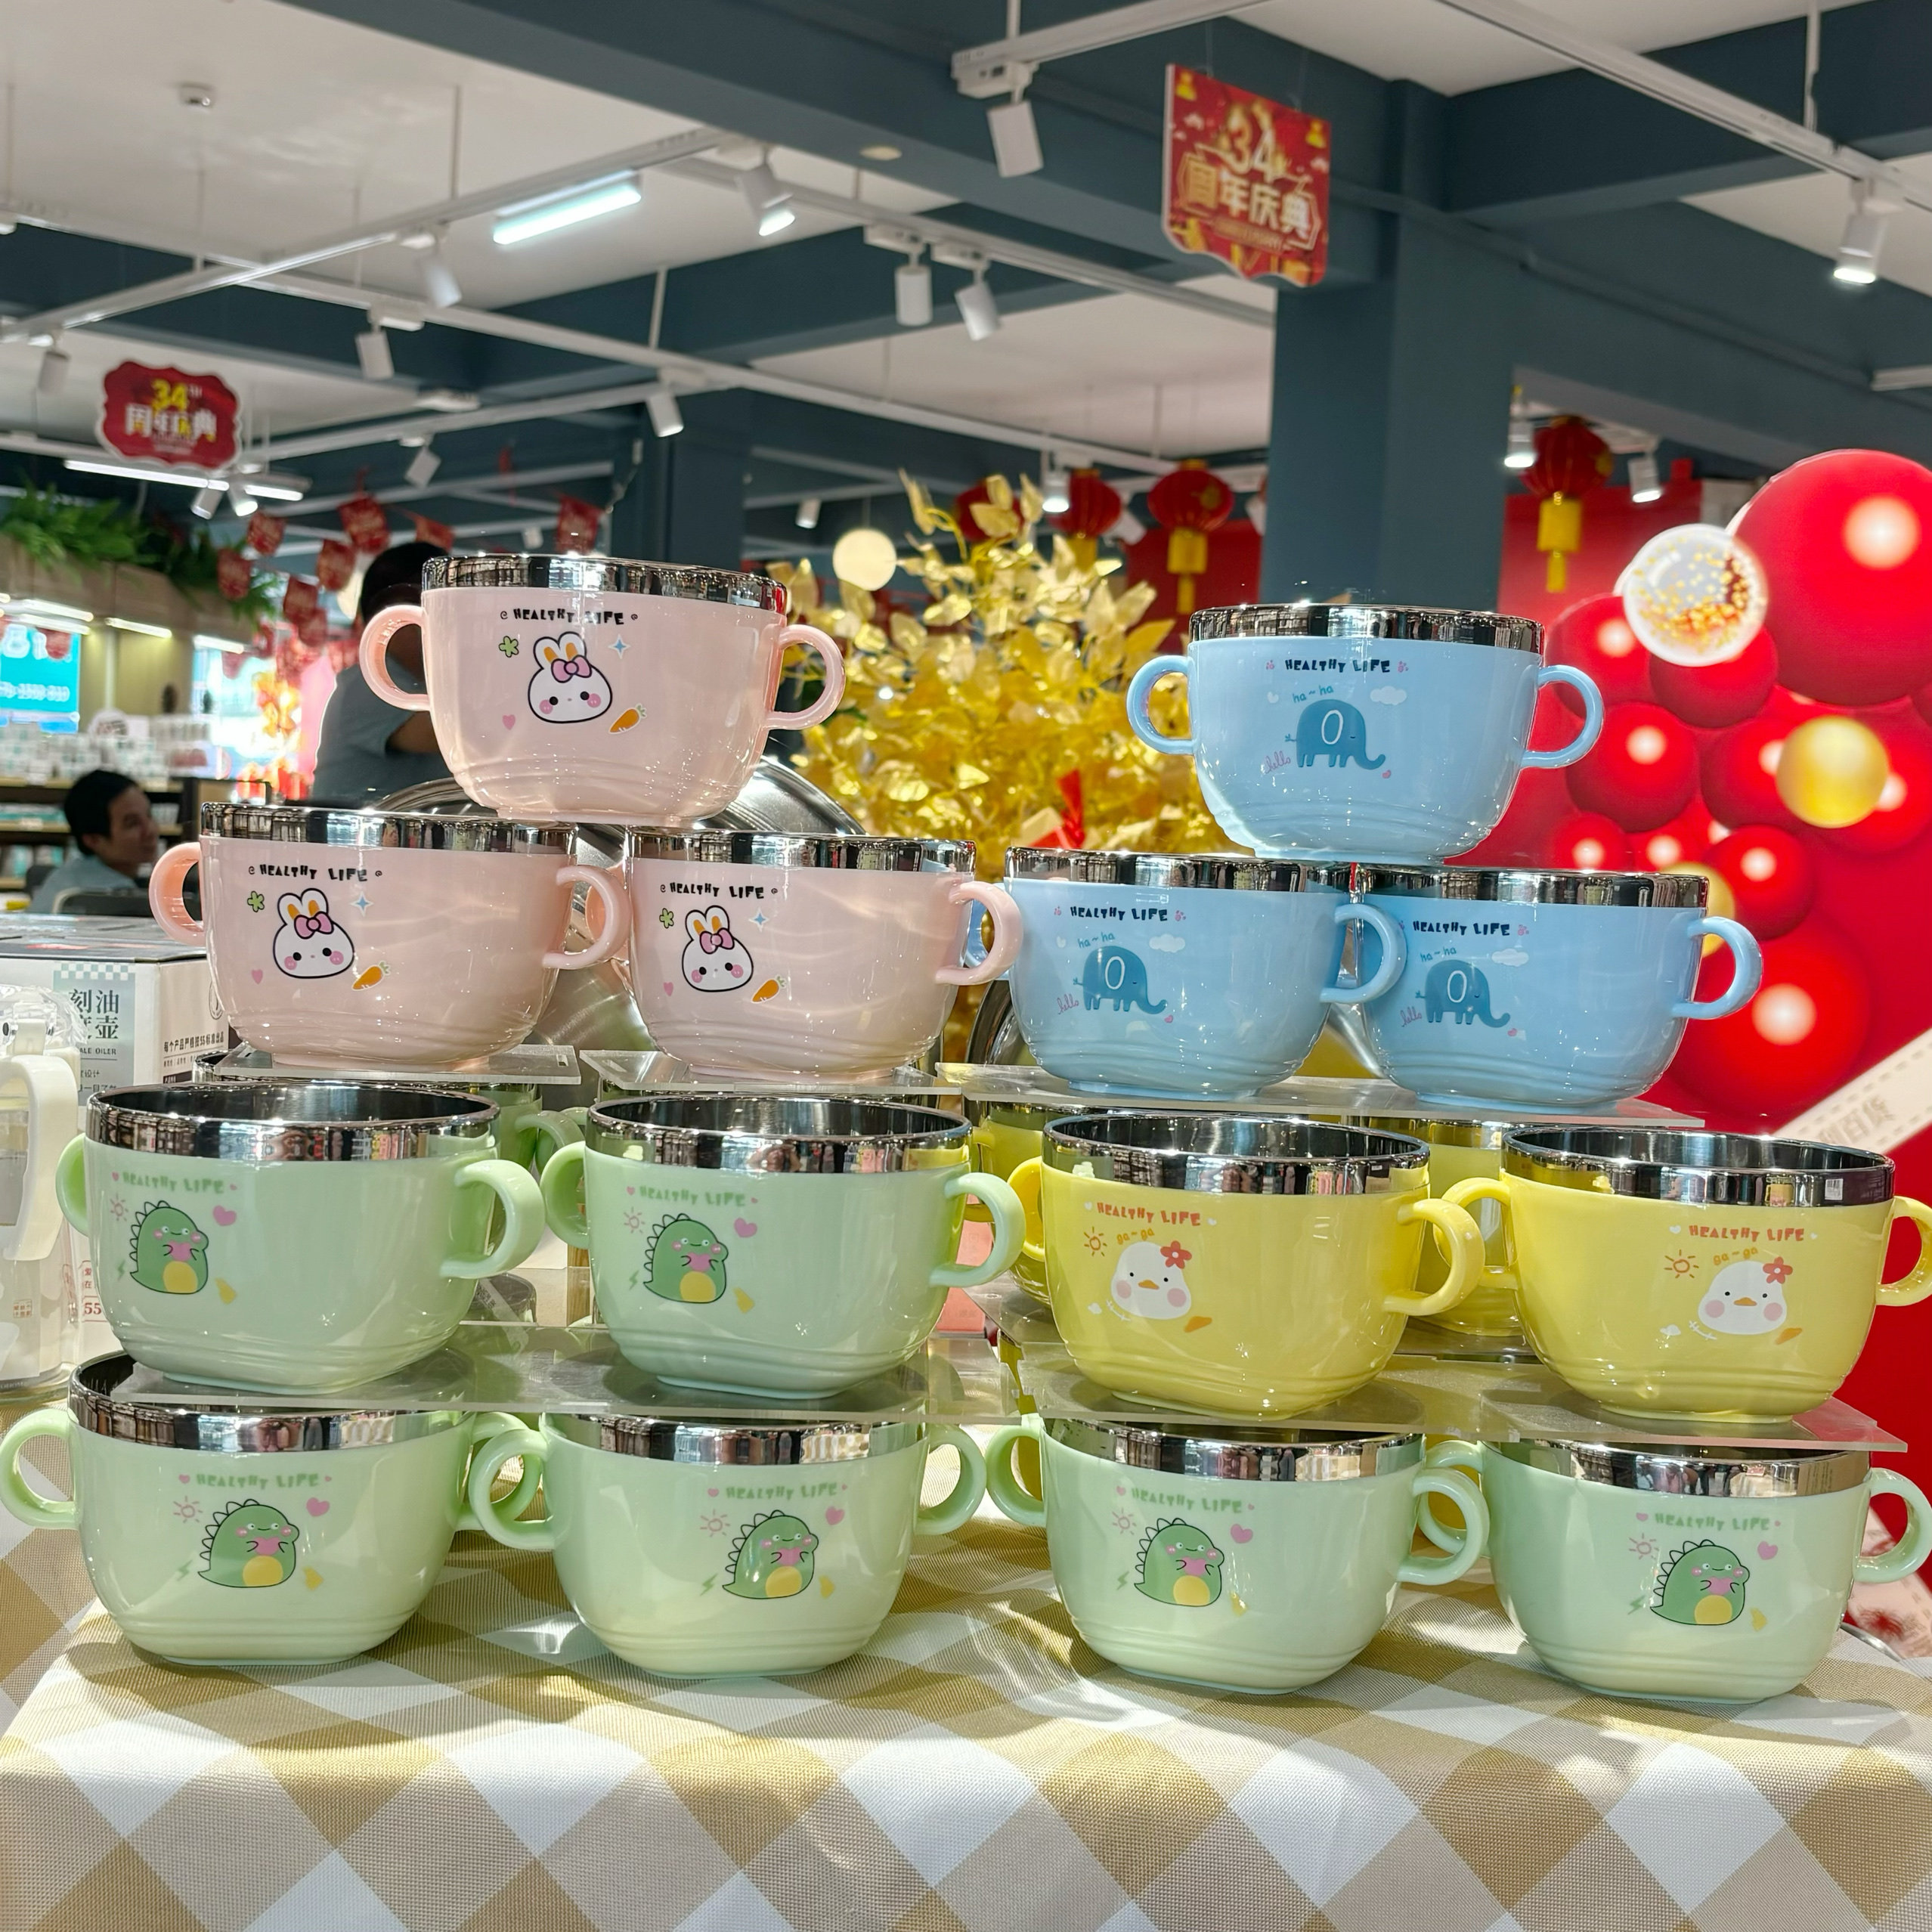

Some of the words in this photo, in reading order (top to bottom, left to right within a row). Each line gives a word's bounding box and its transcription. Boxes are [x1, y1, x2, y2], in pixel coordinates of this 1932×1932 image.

[1215, 99, 1286, 184] 34
[152, 379, 188, 410] 34
[513, 608, 574, 623] HEALTHY
[584, 610, 624, 625] LIFE
[1285, 659, 1346, 673] HEALTHY
[1353, 659, 1390, 673] LIFE
[259, 864, 317, 879] HEALTHY
[328, 868, 367, 881] LIFE
[670, 882, 720, 896] HEALTHY
[729, 885, 764, 899] LIFE
[1070, 906, 1125, 921] HEALTHY
[1132, 908, 1167, 921] LIFE
[1413, 921, 1467, 935] HEALTHY
[1473, 922, 1510, 936] LIFE
[122, 1172, 177, 1191] HEALTHY
[184, 1178, 224, 1194] LIFE
[639, 1186, 698, 1205] HEALTHY
[705, 1191, 745, 1206] LIFE
[1097, 1202, 1154, 1223] HEALTHY
[1161, 1210, 1200, 1226] LIFE
[1689, 1225, 1760, 1242] HEALTHY
[1766, 1228, 1804, 1241] LIFE
[197, 1473, 268, 1490] HEALTHY
[276, 1473, 319, 1488] LIFE
[726, 1485, 794, 1500] HEALTHY
[800, 1482, 838, 1497] LIFE
[1132, 1488, 1194, 1510] HEALTHY
[1202, 1498, 1242, 1513] LIFE
[1655, 1512, 1725, 1531] HEALTHY
[1732, 1517, 1770, 1531] LIFE
